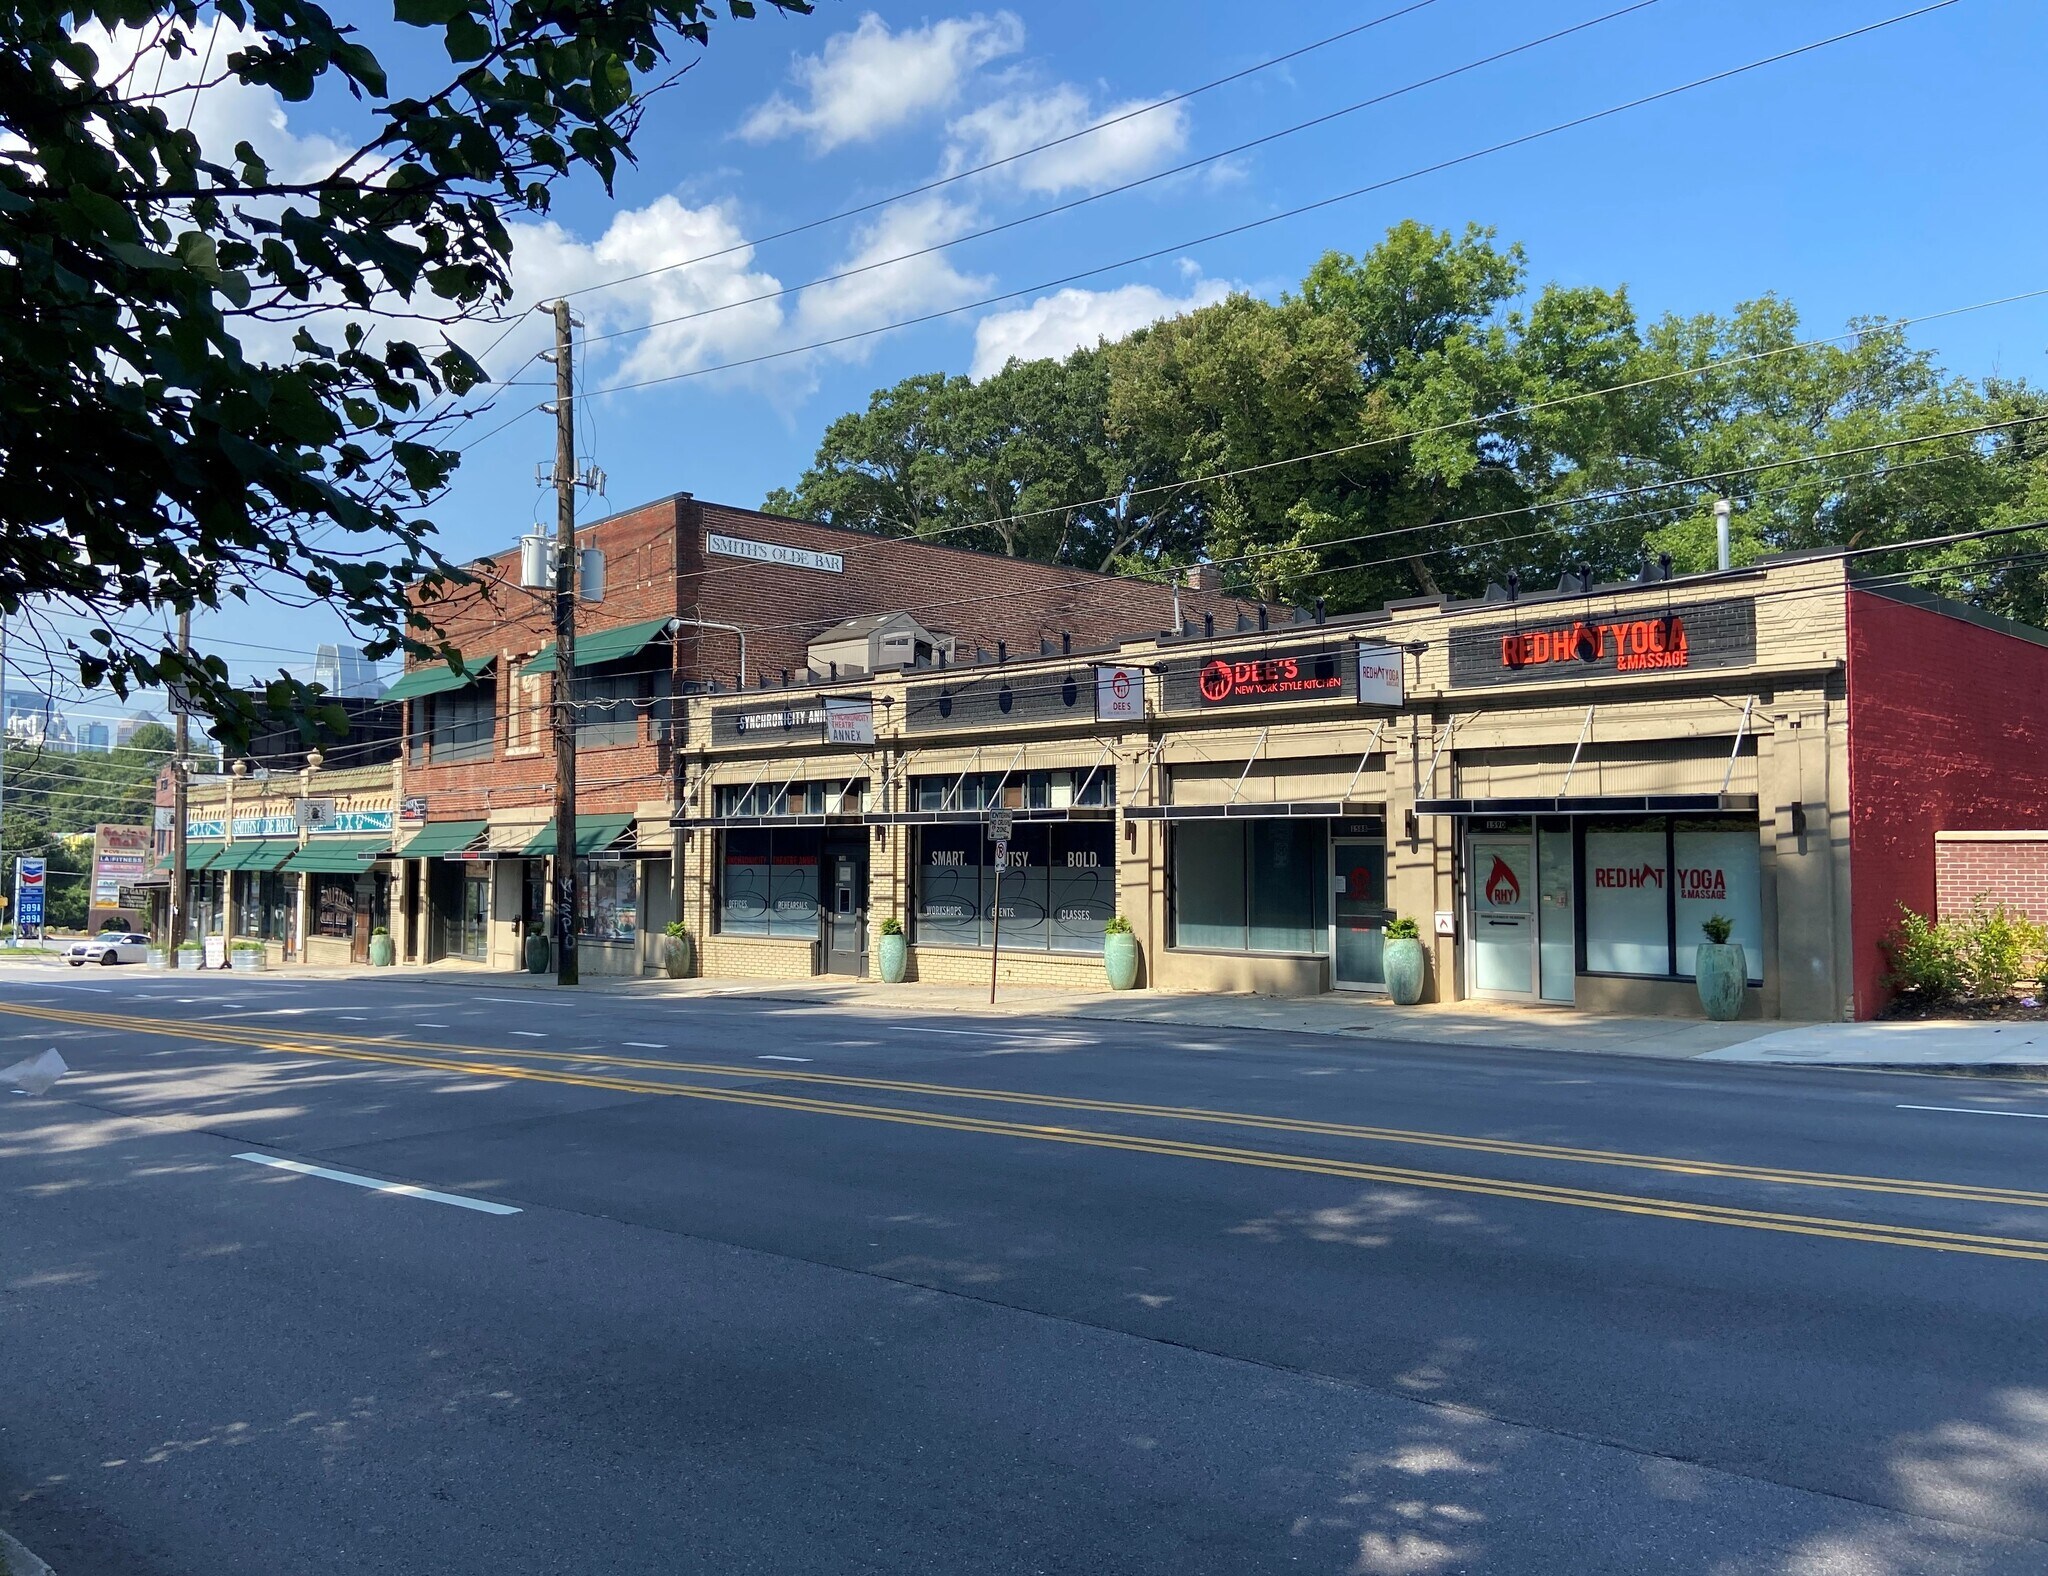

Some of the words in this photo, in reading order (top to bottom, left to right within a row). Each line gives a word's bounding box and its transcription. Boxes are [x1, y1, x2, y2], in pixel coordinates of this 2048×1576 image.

[712, 537, 768, 558] SMITH'S
[772, 548, 810, 565] OLDE
[815, 554, 840, 570] BAR
[1502, 631, 1550, 667] RED
[1610, 617, 1688, 656] YOGA
[1235, 659, 1298, 683] DEE'S
[1362, 666, 1373, 679] RED
[1385, 669, 1399, 681] YOGA
[1235, 684, 1255, 695] NEW
[1255, 682, 1278, 693] YORK
[1279, 680, 1302, 692] STYLE
[1304, 677, 1341, 689] KITCHEN
[1112, 701, 1132, 711] DEE'S
[740, 711, 805, 730] SYNCHRONICITY
[832, 720, 855, 729] THEATRE
[833, 729, 862, 742] ANNEX
[932, 851, 967, 866] SMART.
[1067, 851, 1101, 868] BOLD.
[1595, 868, 1627, 888] RED
[1677, 869, 1726, 889] YOGA
[1494, 889, 1513, 901] RHY
[728, 899, 748, 909] OFFICES.
[777, 901, 809, 911] REHEARSALS.
[926, 906, 964, 916] WORKSHOPS.
[992, 908, 1016, 917] EENTS.
[1061, 910, 1092, 921] CLASSES.
